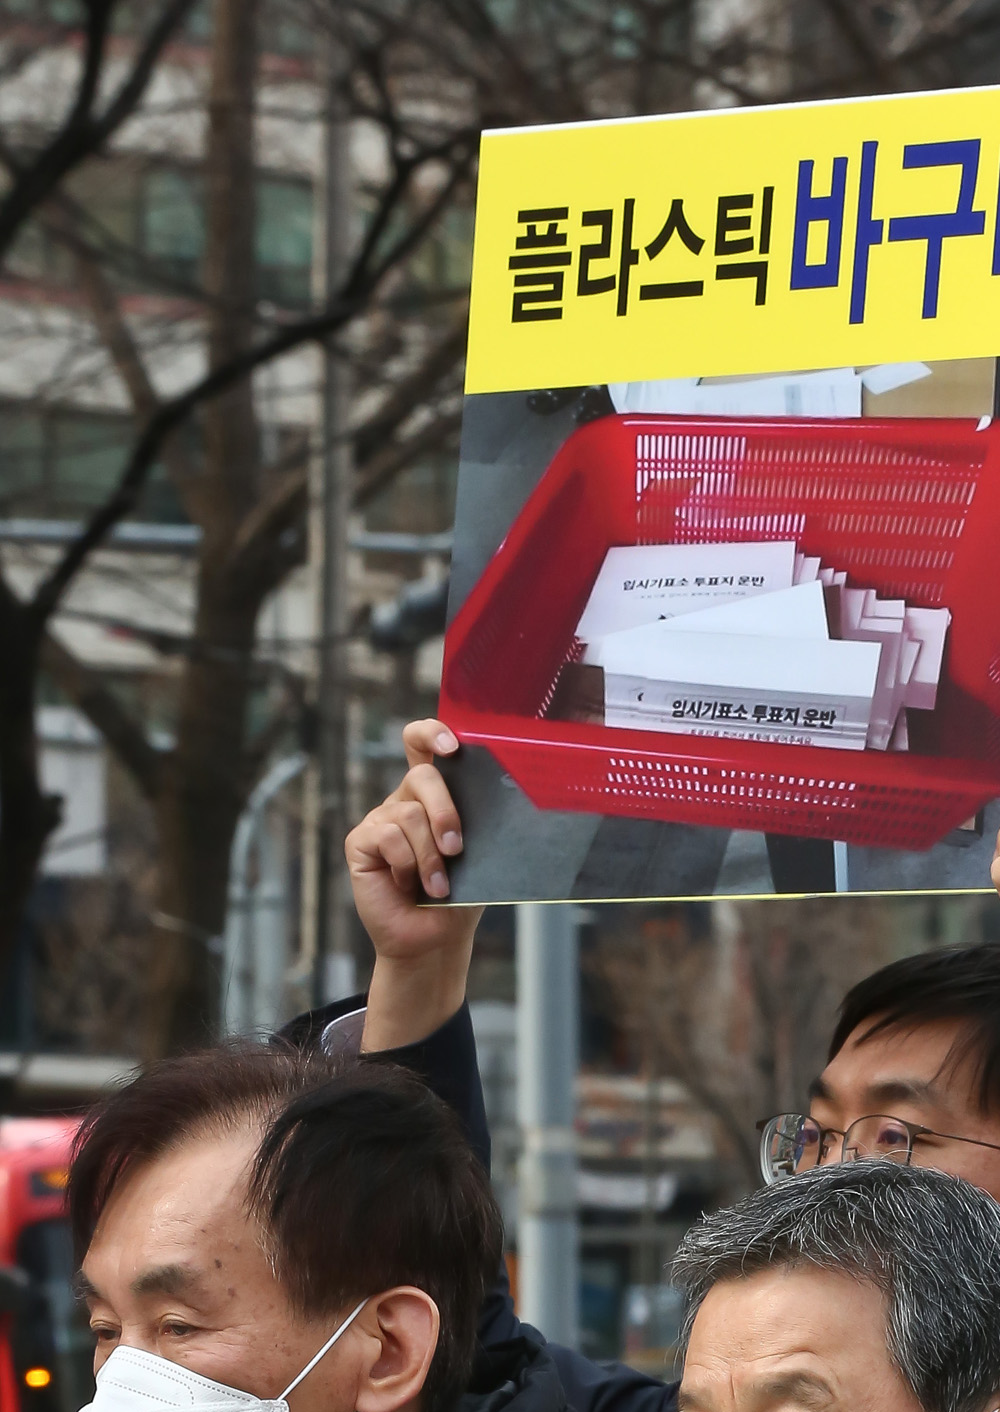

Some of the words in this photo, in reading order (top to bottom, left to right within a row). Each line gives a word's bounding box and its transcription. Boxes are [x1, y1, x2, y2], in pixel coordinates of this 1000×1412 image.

[508, 186, 775, 323] 플라스틱
[623, 577, 689, 591] 임시기표소
[693, 575, 735, 587] 투표지
[738, 575, 765, 588] 운반
[671, 699, 748, 721] 임시기표소
[752, 704, 801, 727] 투표지
[803, 708, 837, 729] 운반
